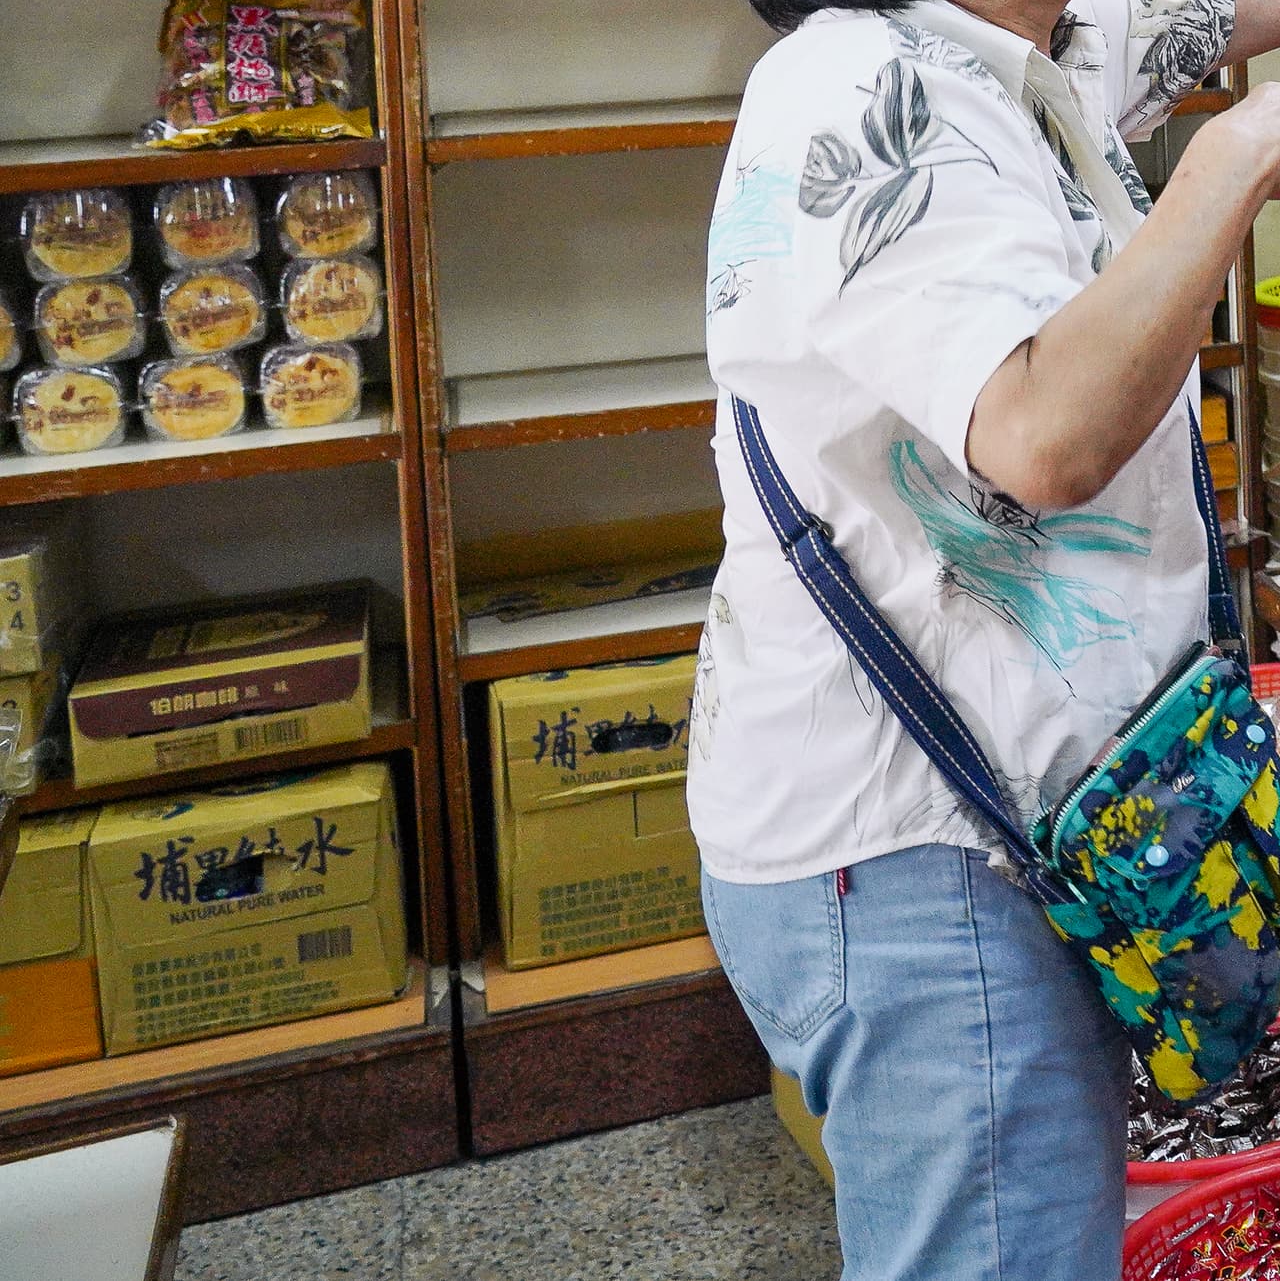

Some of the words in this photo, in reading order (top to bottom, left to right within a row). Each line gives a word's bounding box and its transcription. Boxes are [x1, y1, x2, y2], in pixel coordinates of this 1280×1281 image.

[169, 903, 235, 925] NATURAL
[238, 895, 275, 913] PURE
[279, 884, 326, 904] WATER
